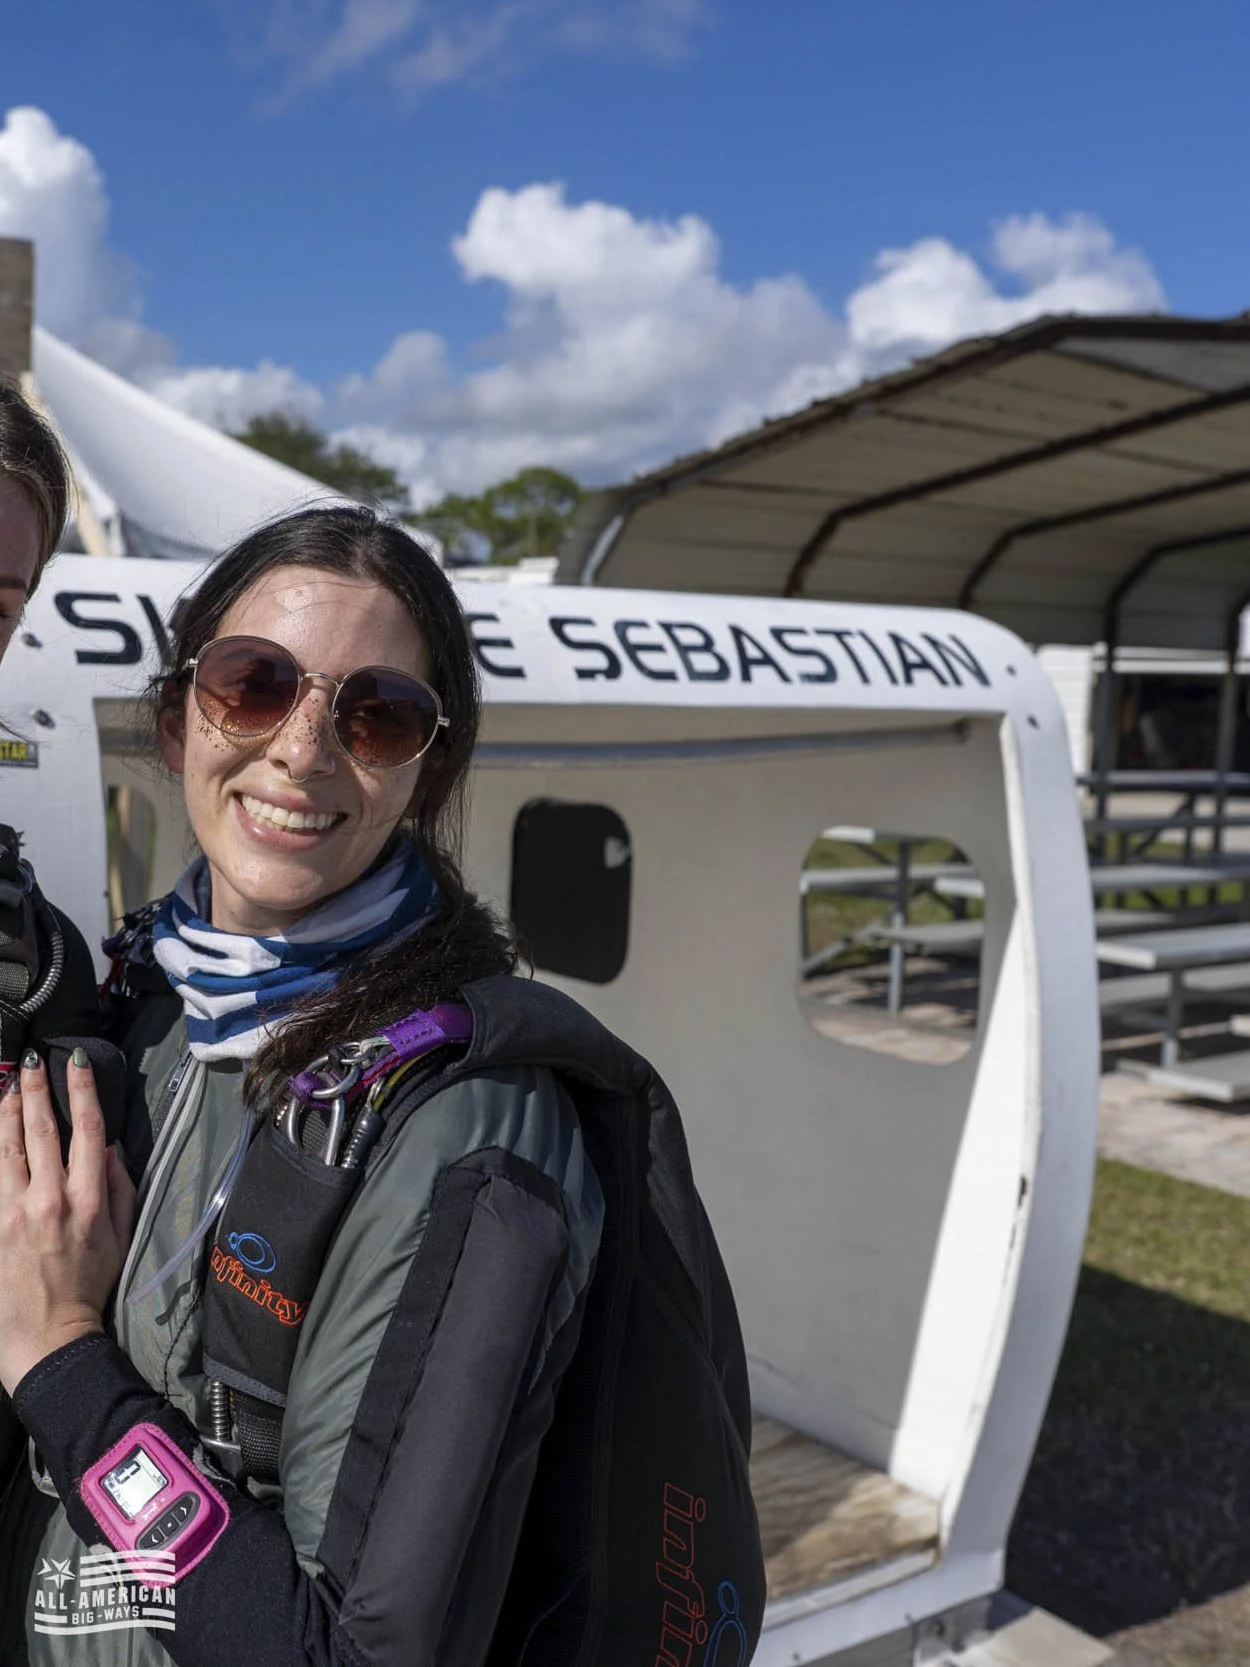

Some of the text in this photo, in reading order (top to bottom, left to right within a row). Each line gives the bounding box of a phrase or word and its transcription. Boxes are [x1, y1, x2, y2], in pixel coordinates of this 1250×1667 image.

[549, 617, 991, 688] SEBASTIAN
[211, 1246, 309, 1327] nfinity
[655, 1482, 708, 1667] infin
